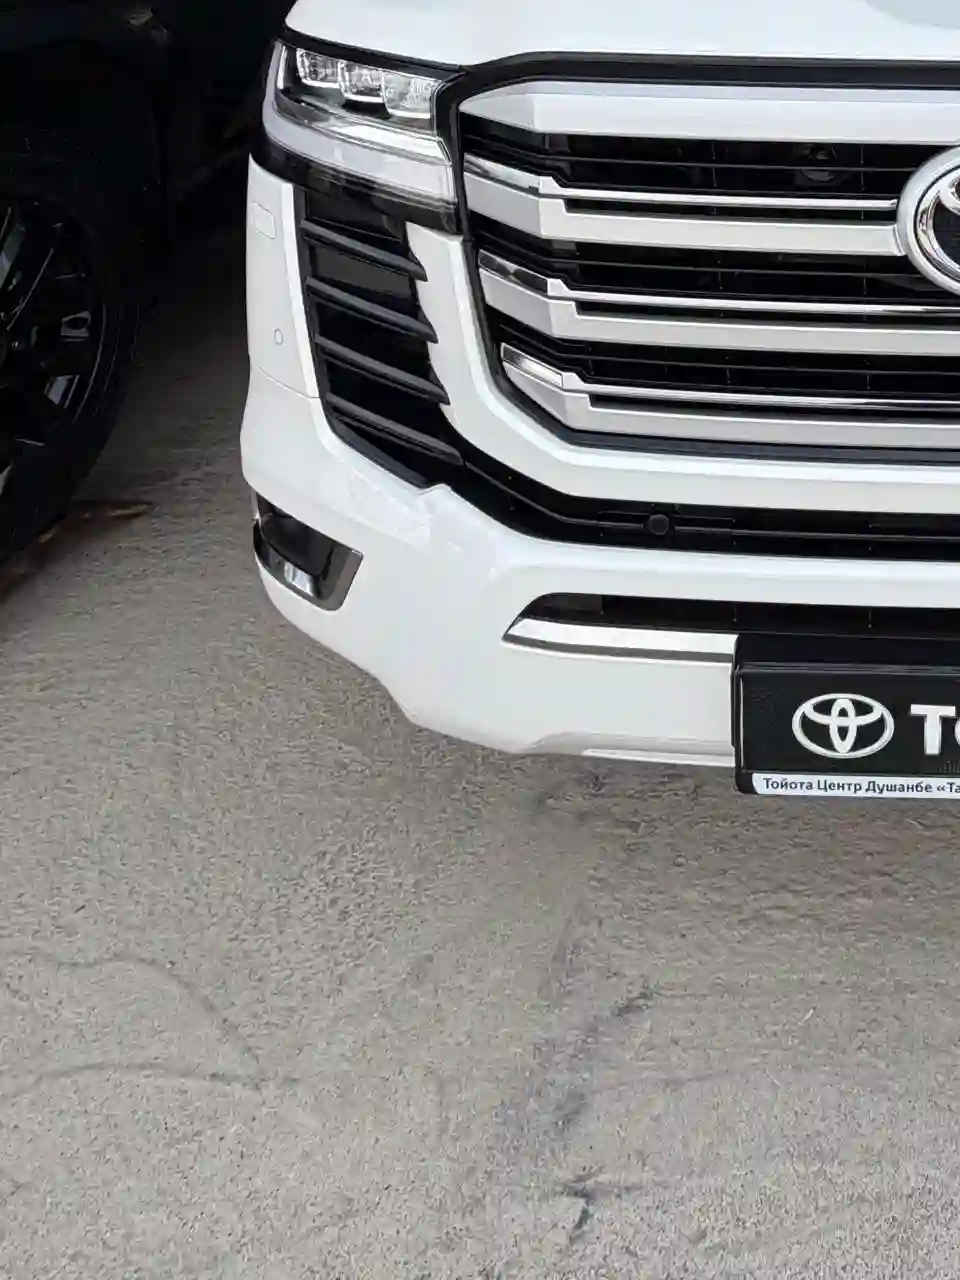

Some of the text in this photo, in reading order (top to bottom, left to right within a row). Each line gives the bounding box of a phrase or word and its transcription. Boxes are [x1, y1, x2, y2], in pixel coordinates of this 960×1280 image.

[763, 776, 813, 791] Тойота
[817, 778, 863, 794] Центр
[865, 780, 933, 795] Душанбе
